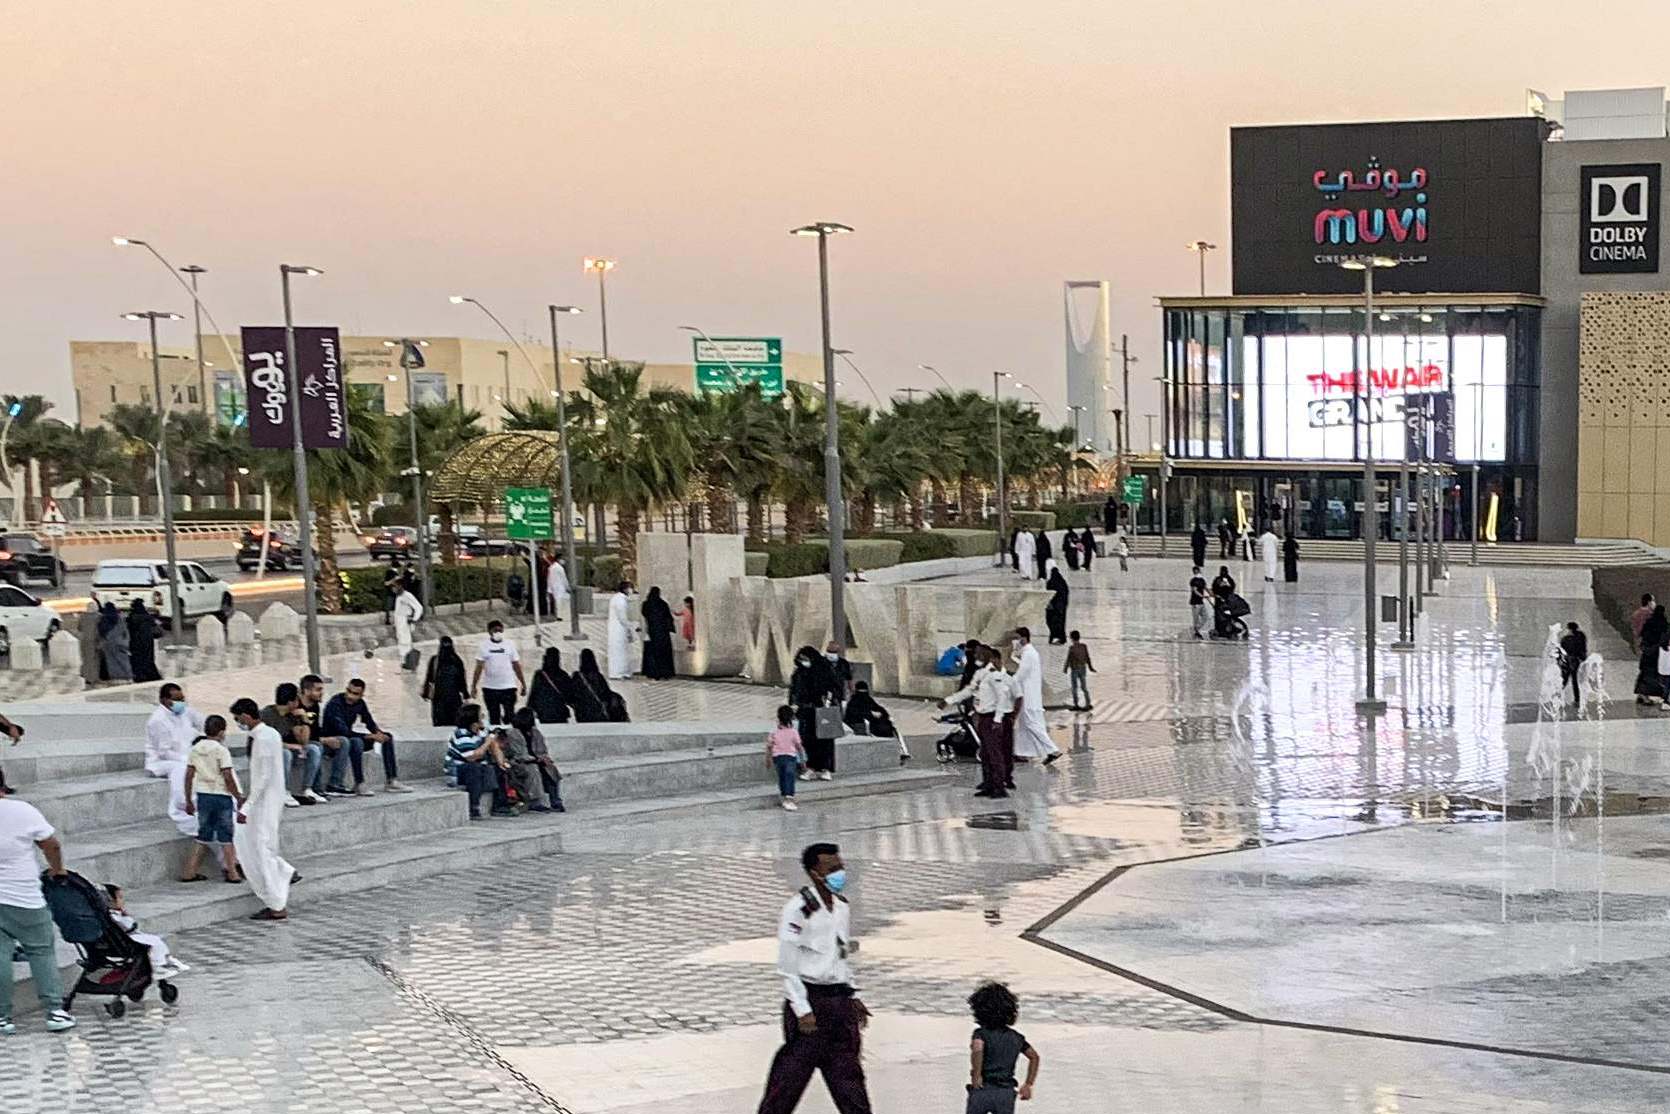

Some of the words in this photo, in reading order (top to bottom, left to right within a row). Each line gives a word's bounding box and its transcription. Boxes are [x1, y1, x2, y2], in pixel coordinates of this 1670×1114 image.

[1314, 192, 1427, 244] muvi
[1590, 227, 1647, 243] DOLBY
[1590, 245, 1647, 261] CINEMA
